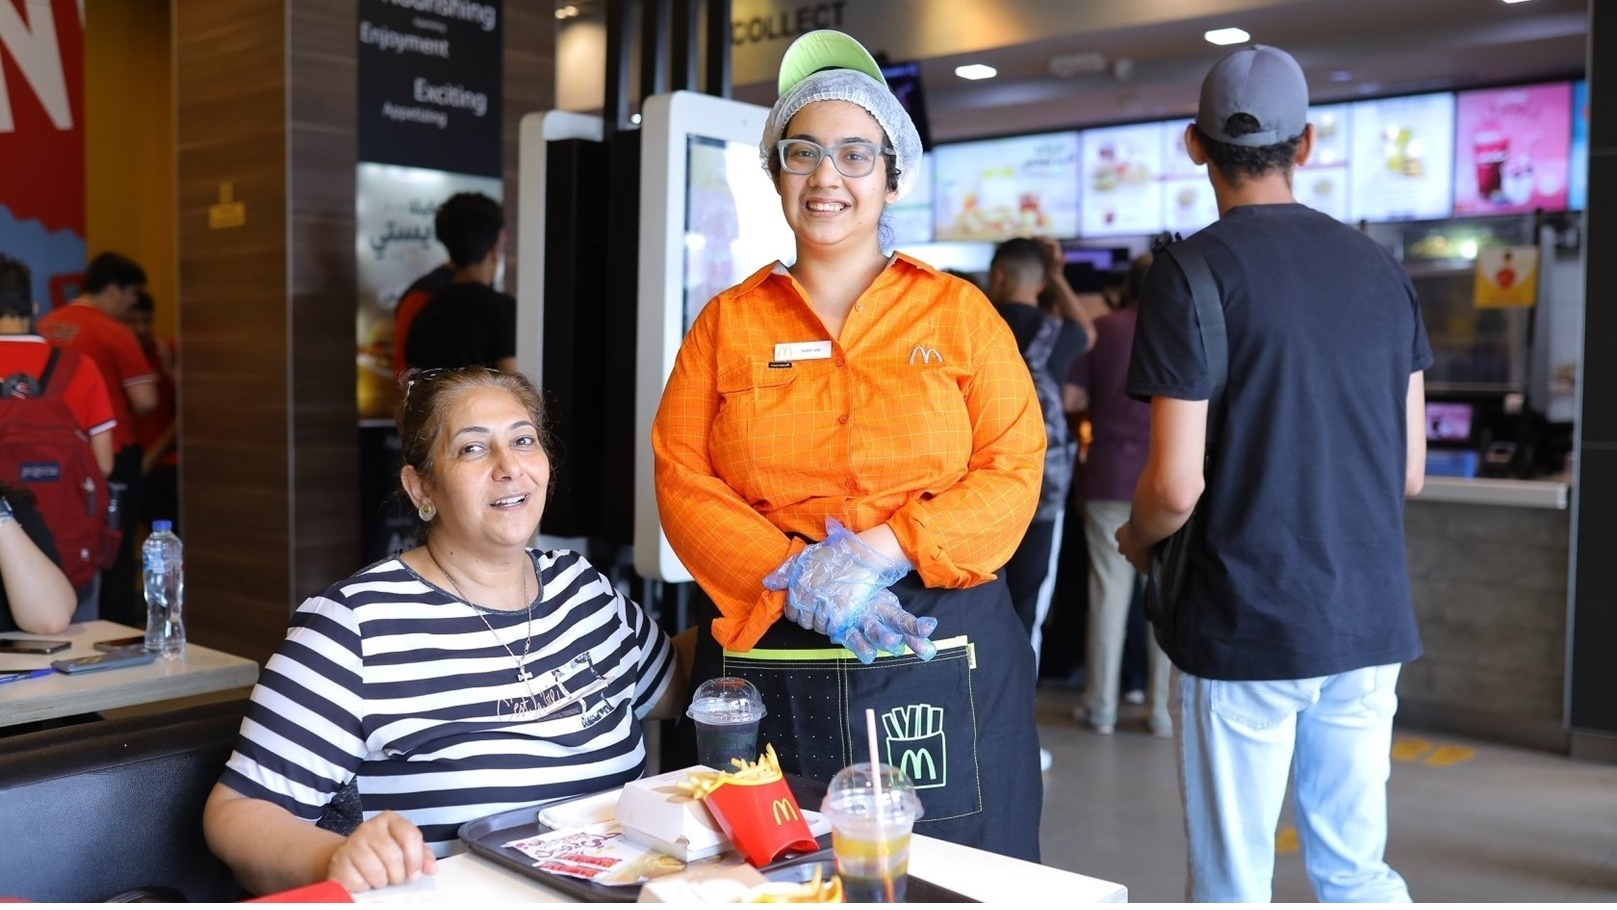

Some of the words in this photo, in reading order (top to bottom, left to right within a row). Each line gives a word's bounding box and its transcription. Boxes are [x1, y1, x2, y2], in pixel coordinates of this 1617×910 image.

[382, 0, 497, 32] ourishing
[731, 2, 847, 46] COLLECT
[359, 20, 450, 59] Enjoyment
[382, 101, 448, 129] Appetizing
[413, 76, 489, 117] Exciting
